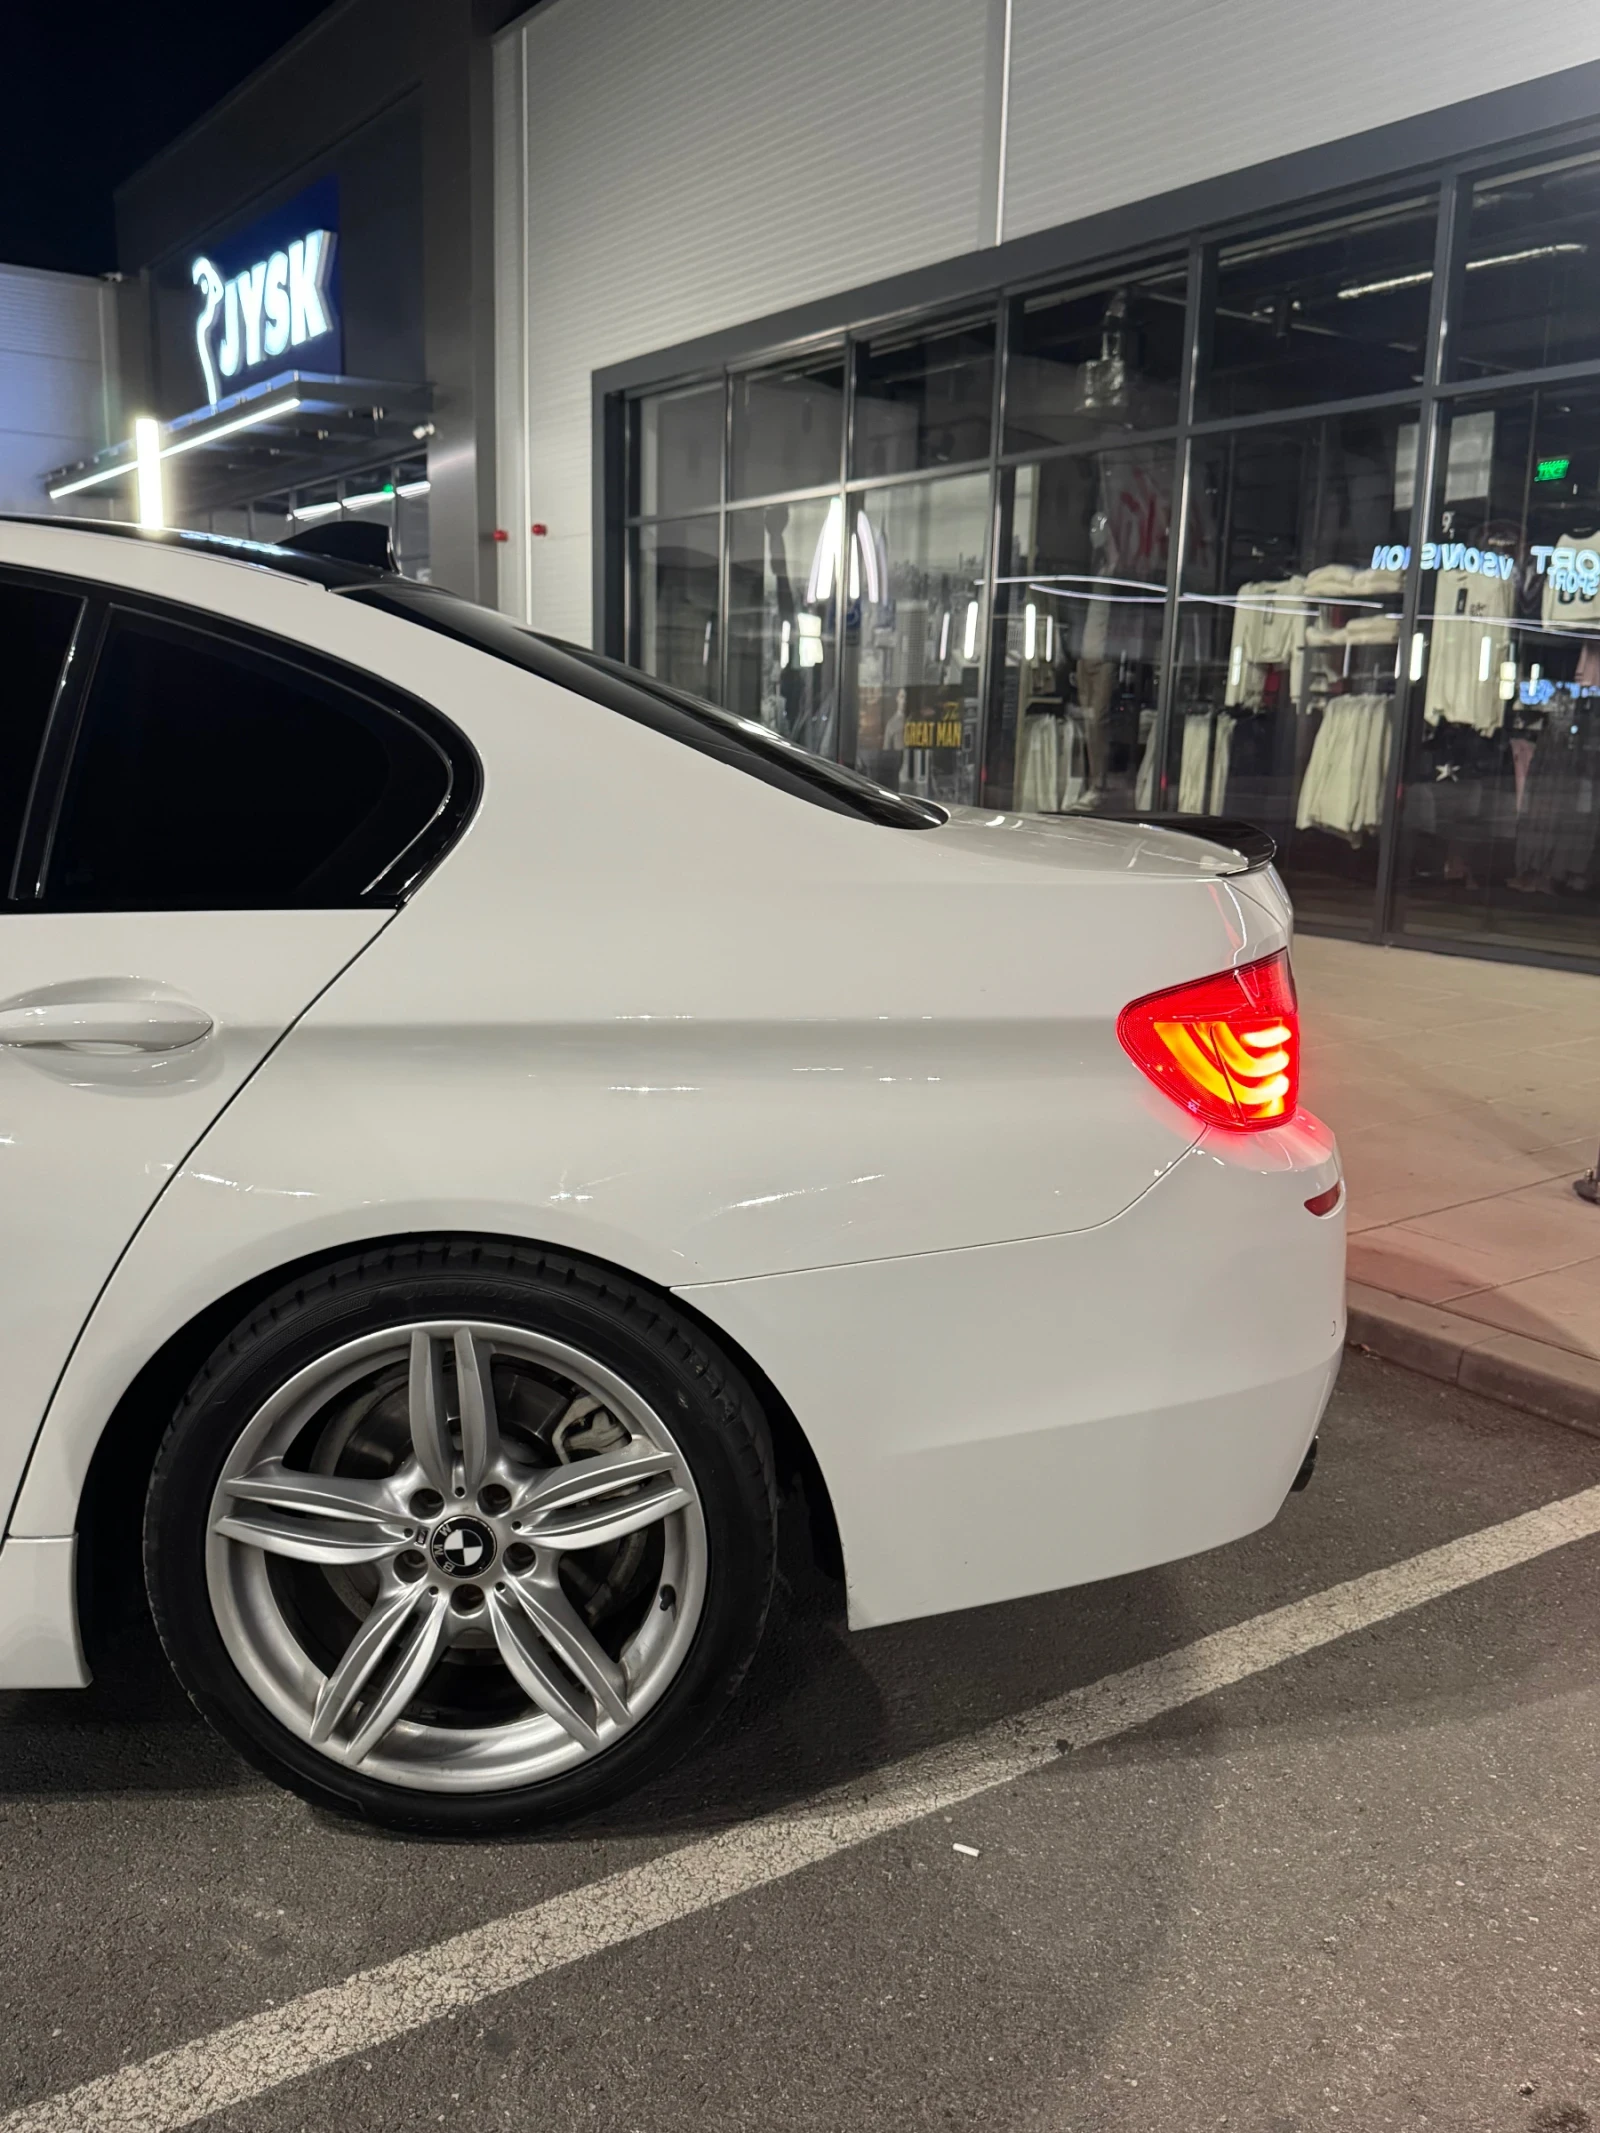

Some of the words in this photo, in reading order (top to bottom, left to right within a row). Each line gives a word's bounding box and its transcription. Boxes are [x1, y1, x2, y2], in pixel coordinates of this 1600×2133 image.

[219, 229, 328, 377] JYSK
[904, 721, 935, 747] GREAT
[936, 721, 962, 748] MAN
[433, 1523, 456, 1573] BMW
